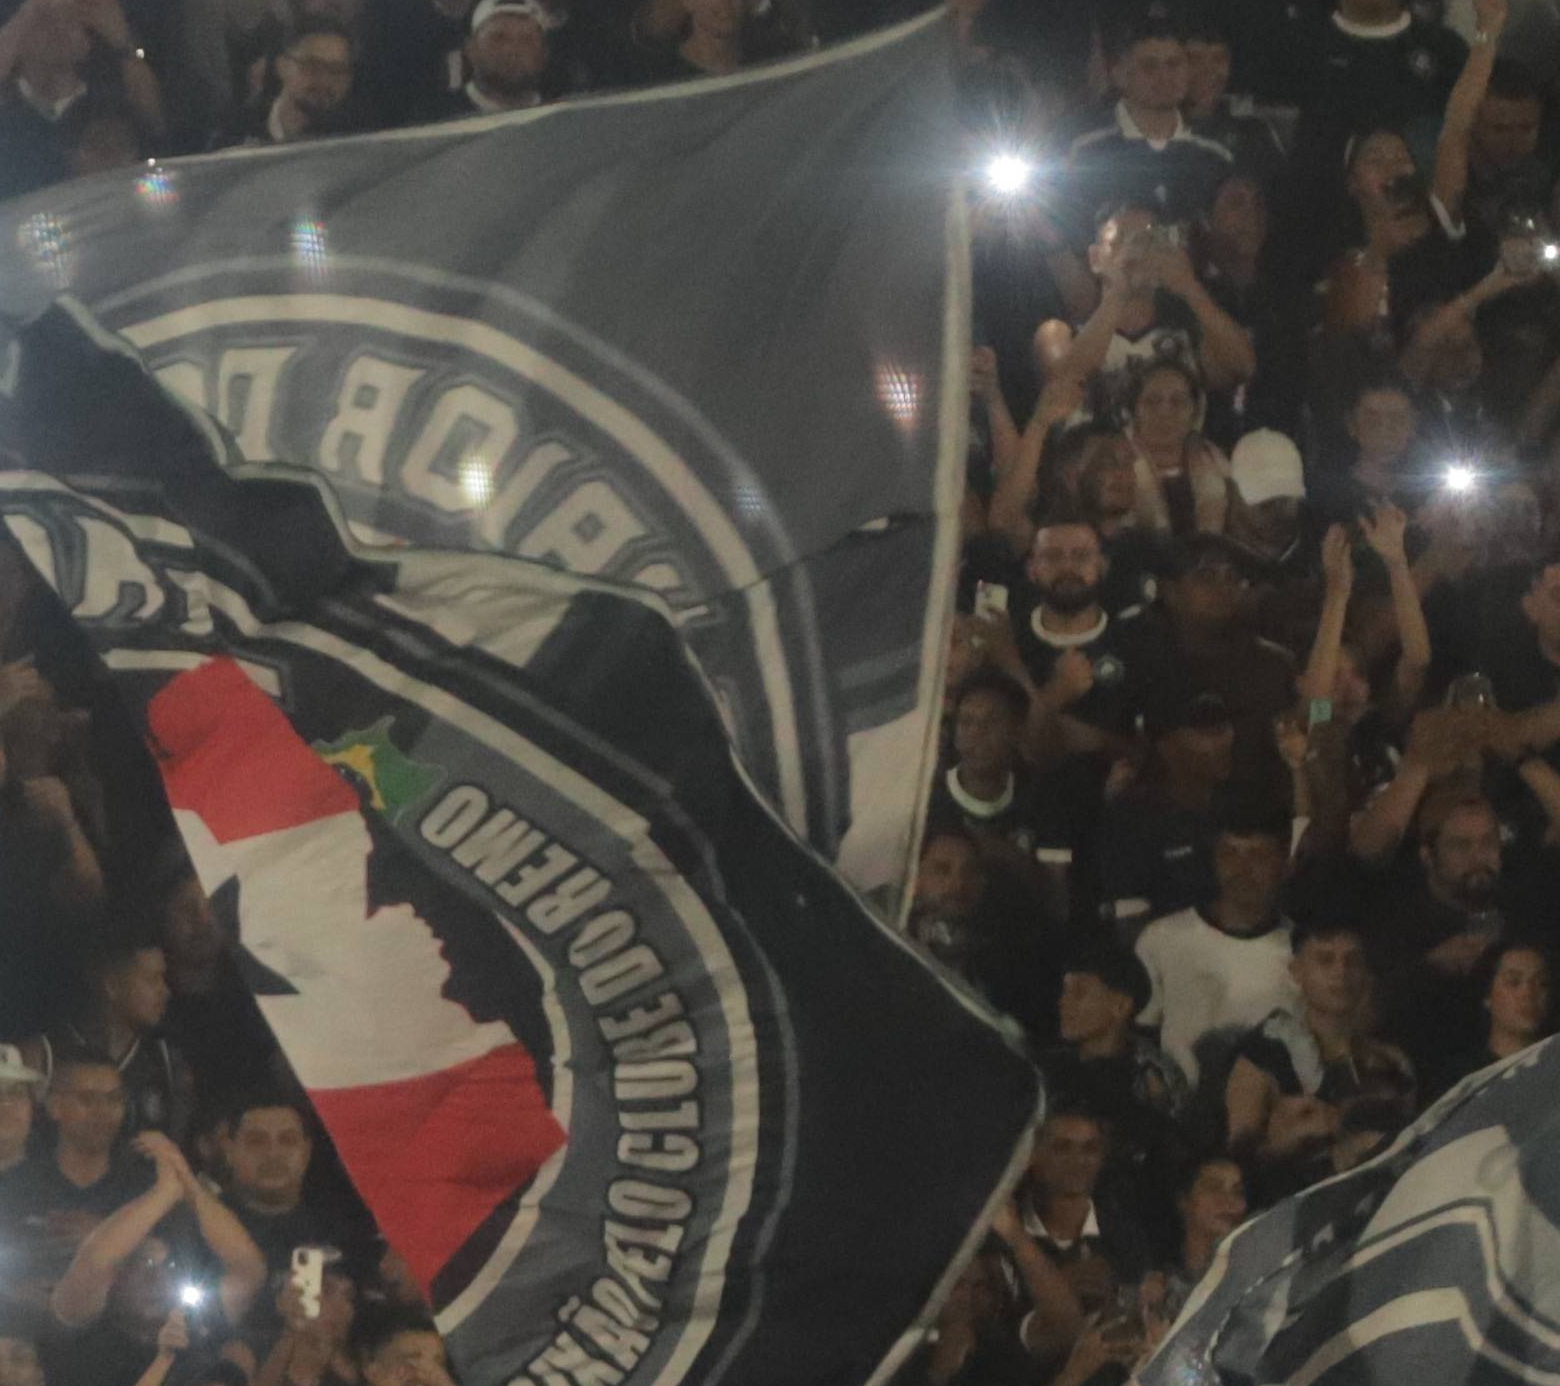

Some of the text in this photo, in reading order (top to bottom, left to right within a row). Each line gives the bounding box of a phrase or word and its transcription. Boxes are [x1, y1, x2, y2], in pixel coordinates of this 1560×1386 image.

[419, 783, 613, 936] REMO
[568, 910, 665, 1006] DO
[597, 990, 701, 1173] CLUBE
